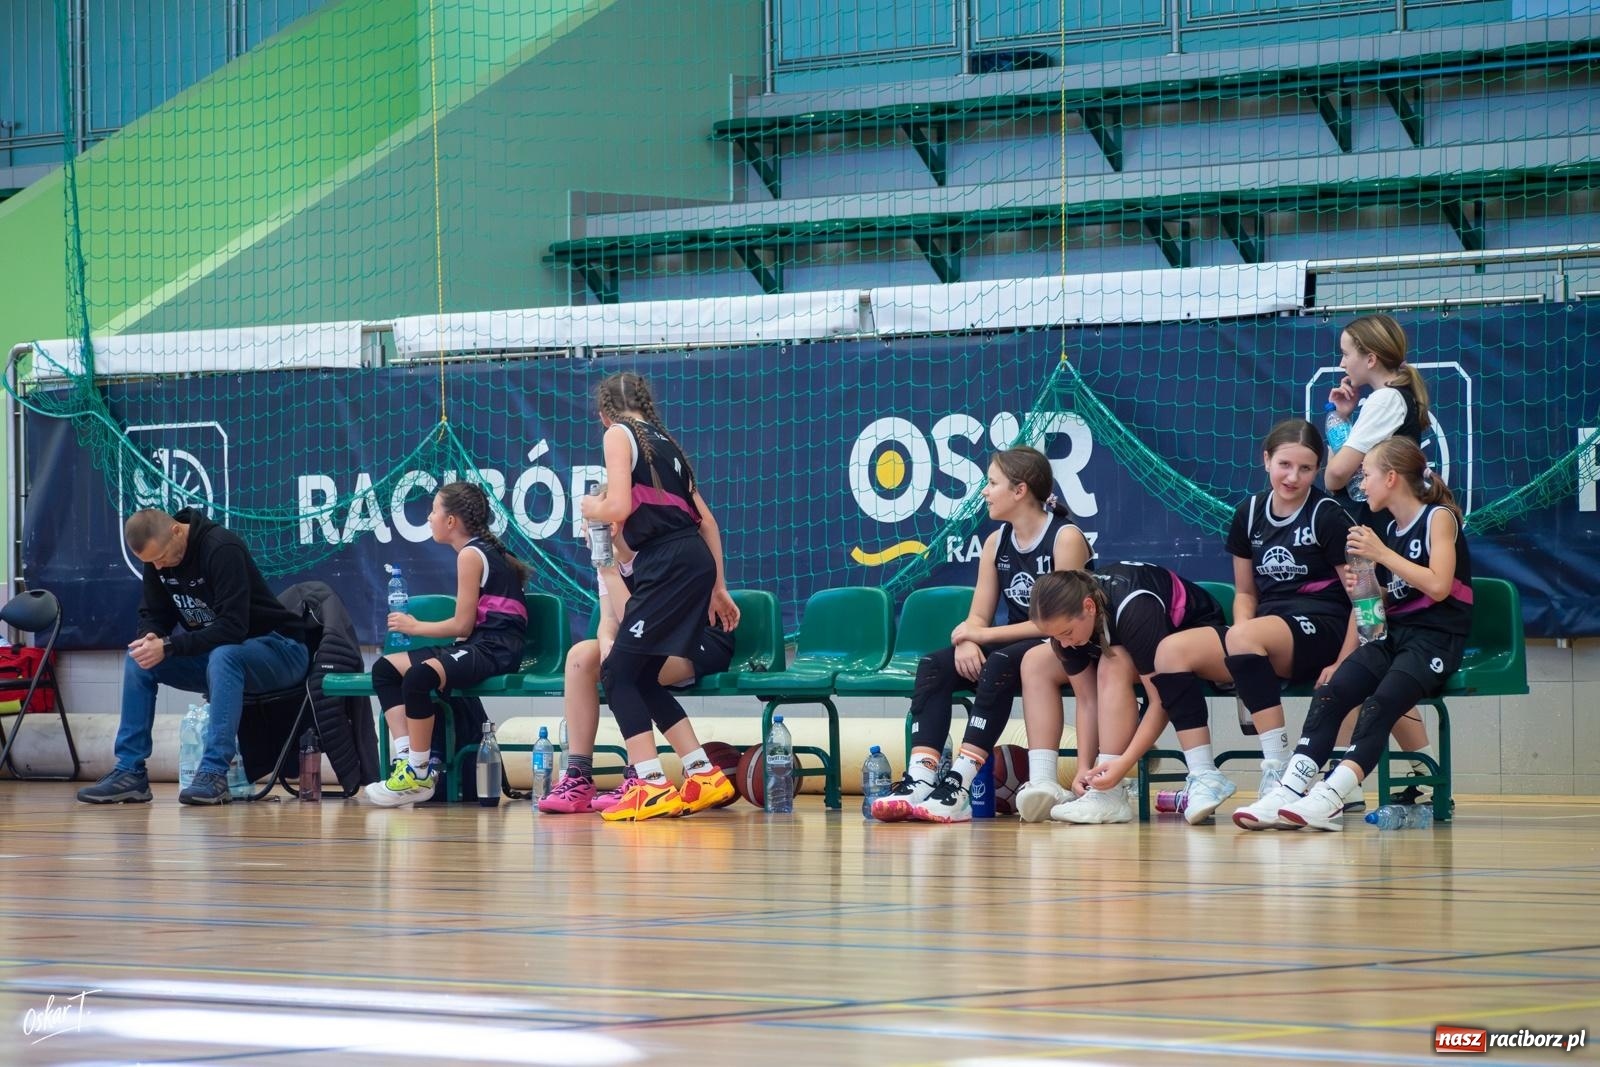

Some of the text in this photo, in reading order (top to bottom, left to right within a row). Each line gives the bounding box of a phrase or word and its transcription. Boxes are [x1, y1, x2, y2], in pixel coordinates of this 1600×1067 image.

[849, 411, 1099, 523] OSR
[1292, 526, 1316, 547] 18
[1409, 539, 1422, 559] 9
[629, 619, 645, 638] 4
[1292, 615, 1317, 635] 18
[450, 649, 469, 662] 1
[1429, 657, 1444, 674] 9
